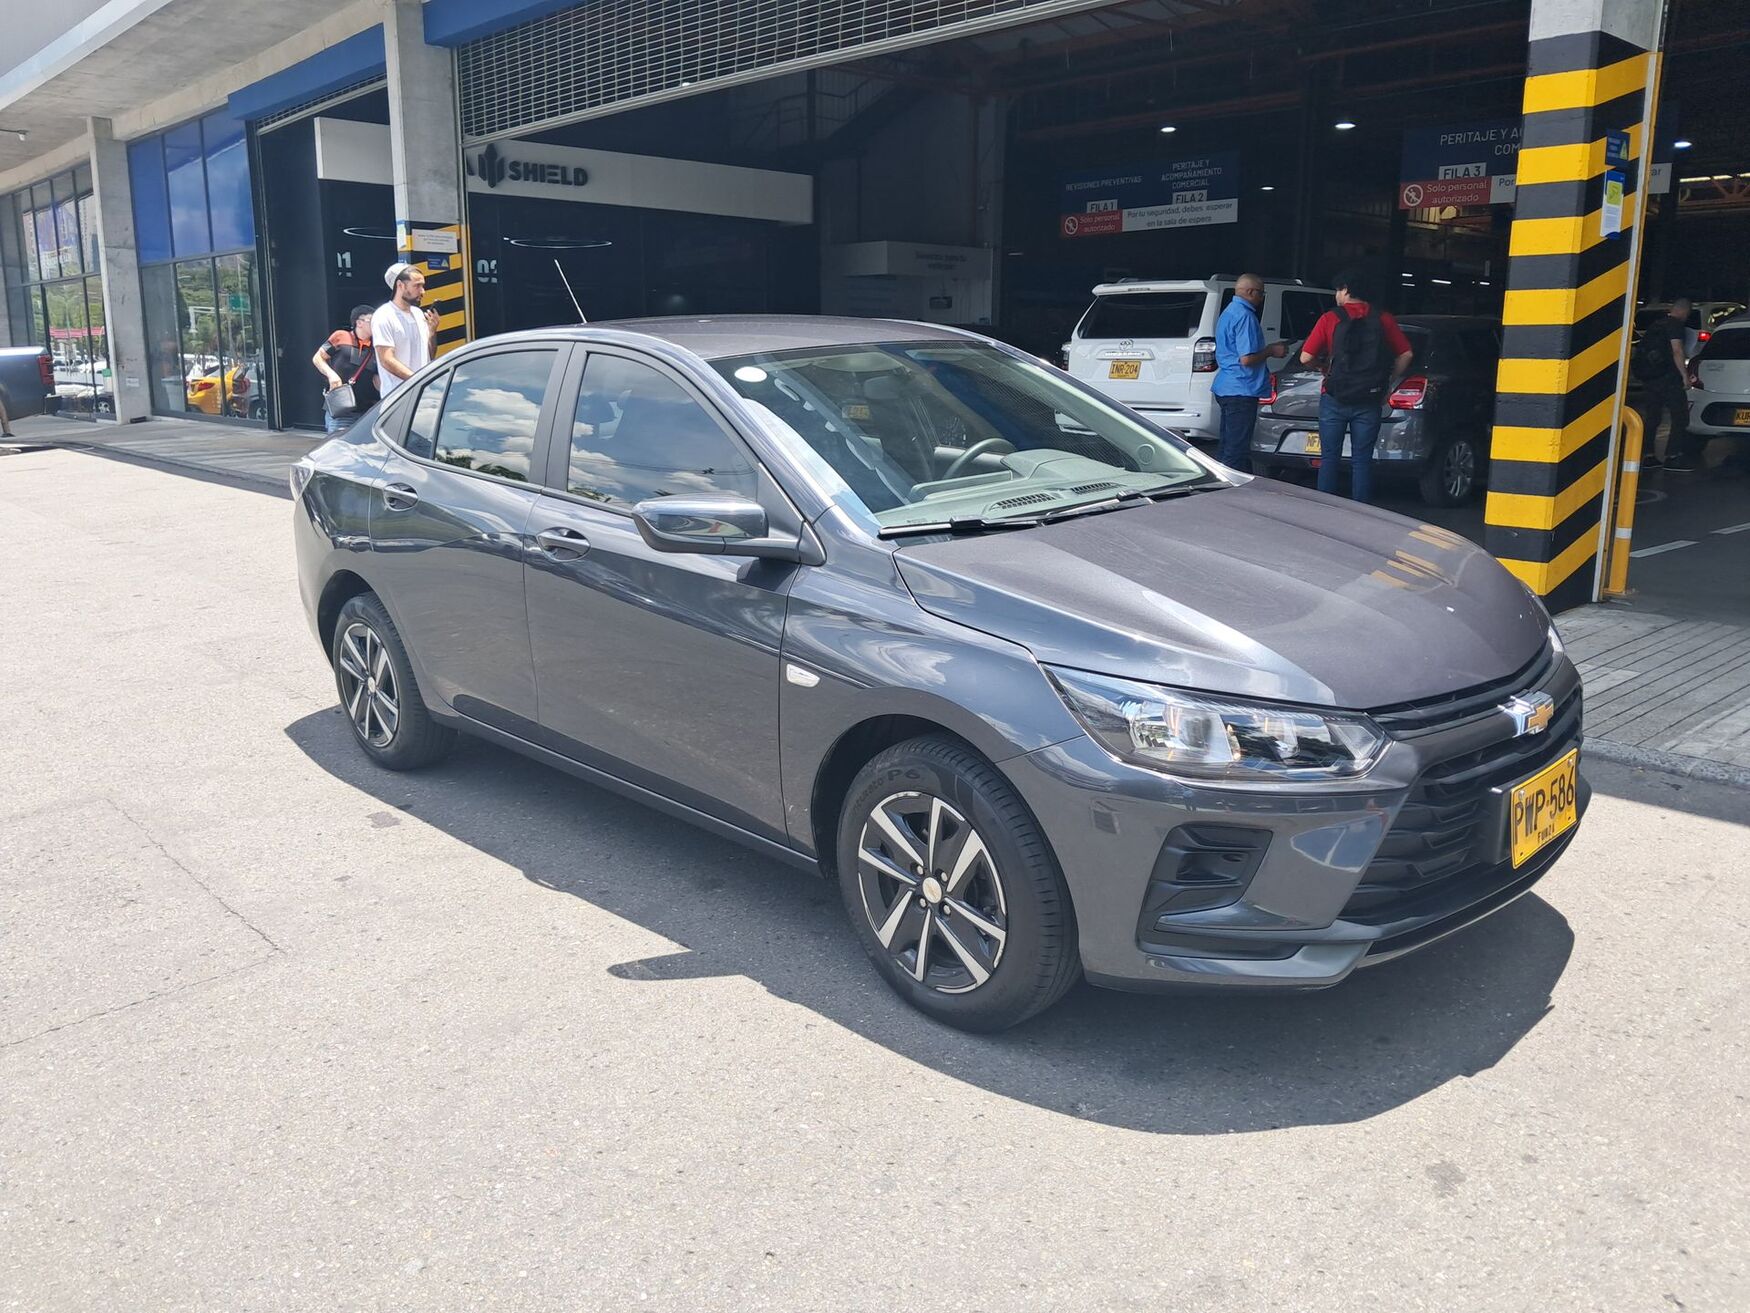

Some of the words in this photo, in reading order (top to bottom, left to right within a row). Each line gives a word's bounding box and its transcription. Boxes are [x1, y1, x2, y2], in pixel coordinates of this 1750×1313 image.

[1440, 130, 1497, 145] PERITAJE
[1500, 129, 1508, 139] Y
[1172, 160, 1204, 170] PERITAJE
[1205, 159, 1210, 167] Y
[508, 160, 589, 186] SHIELD
[1444, 167, 1470, 179] FILA
[1474, 166, 1481, 177] 3
[1101, 175, 1143, 187] PREVENTIVAS
[1172, 179, 1210, 189] COMERCIAL
[1426, 182, 1446, 192] Solo
[1448, 180, 1487, 193] personal
[1176, 193, 1196, 204] FILA
[1198, 193, 1204, 202] 2
[1432, 193, 1479, 204] autorizado
[1090, 203, 1109, 212] FILA
[1205, 202, 1232, 213] esperar
[1079, 215, 1093, 224] Solo
[1094, 213, 1120, 224] personal
[1178, 217, 1187, 225] de
[1188, 216, 1212, 226] espera
[887, 768, 921, 782] P6
